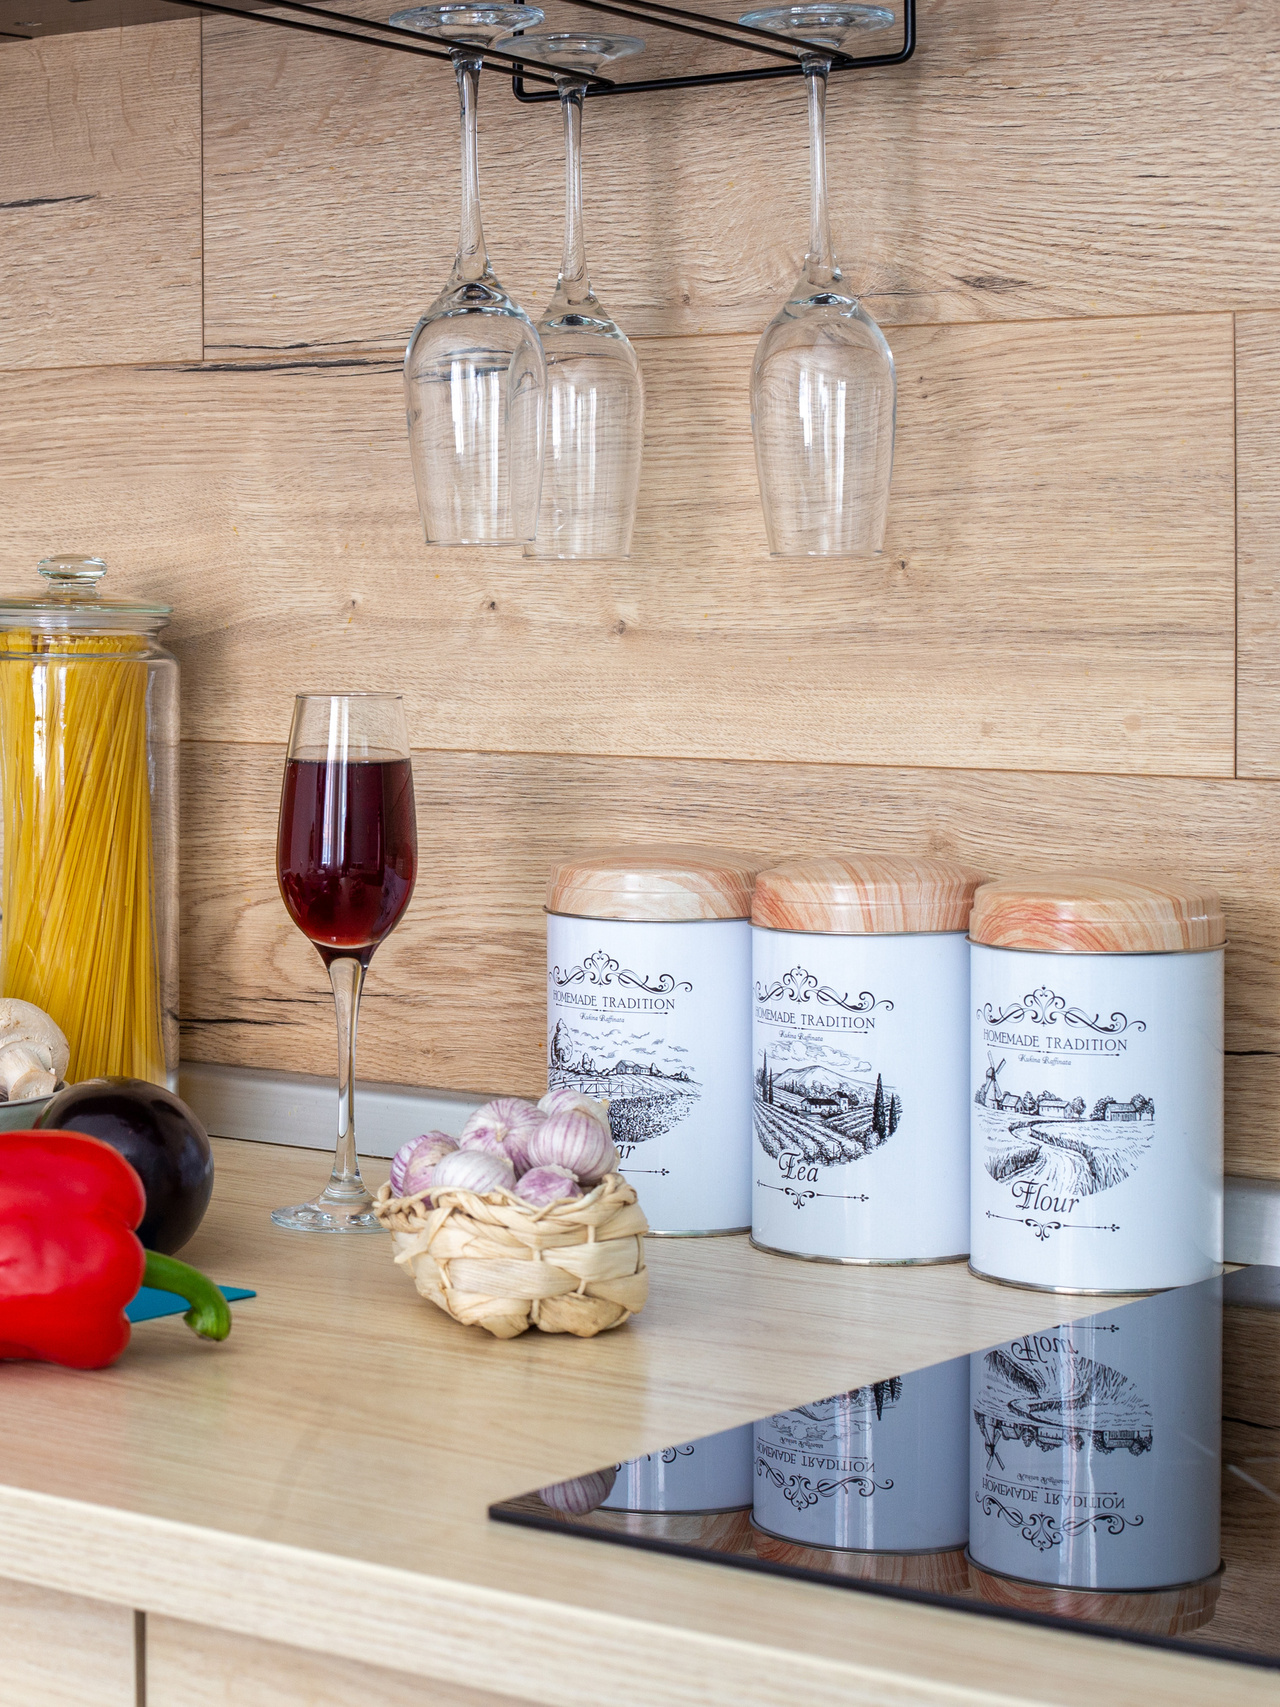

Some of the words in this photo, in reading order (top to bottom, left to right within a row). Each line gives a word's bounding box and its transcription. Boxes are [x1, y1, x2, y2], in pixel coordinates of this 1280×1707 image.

[553, 990, 597, 1007] HOMEMADE
[603, 997, 675, 1010] TRADITION
[599, 1014, 625, 1023] Raffinata
[755, 1006, 796, 1024] HOMEMADE
[801, 1014, 876, 1029] TRADITION
[983, 1028, 1040, 1047] HOMEMADE
[1046, 1036, 1127, 1051] TRADITION
[1042, 1055, 1072, 1066] Raffinata
[778, 1152, 819, 1182] Tea
[1011, 1179, 1080, 1213] Flour
